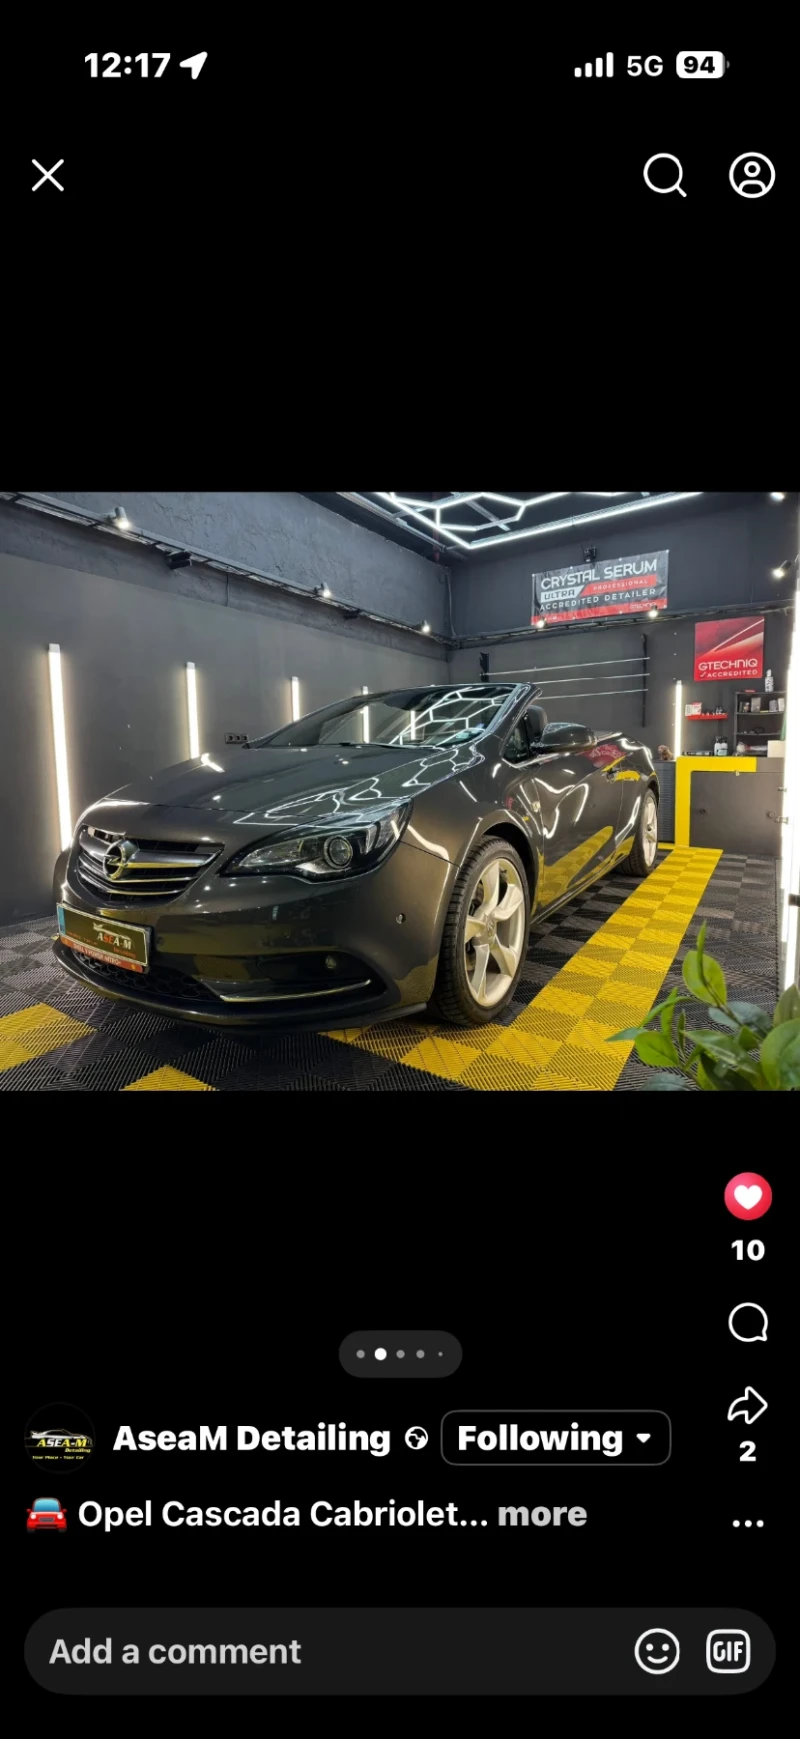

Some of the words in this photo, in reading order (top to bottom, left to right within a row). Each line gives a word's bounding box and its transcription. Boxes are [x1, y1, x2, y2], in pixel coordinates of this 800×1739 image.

[541, 569, 600, 590] CRYSTAL
[604, 558, 657, 579] SERUM
[593, 579, 648, 591] PROFESSIONAL
[540, 597, 599, 611] ACCREDITED
[605, 588, 656, 601] DETAILER
[545, 588, 575, 600] ULTRA
[698, 658, 758, 671] GTECHNIQ
[707, 669, 758, 677] ACCREDITED
[97, 932, 132, 950] ASEA-M
